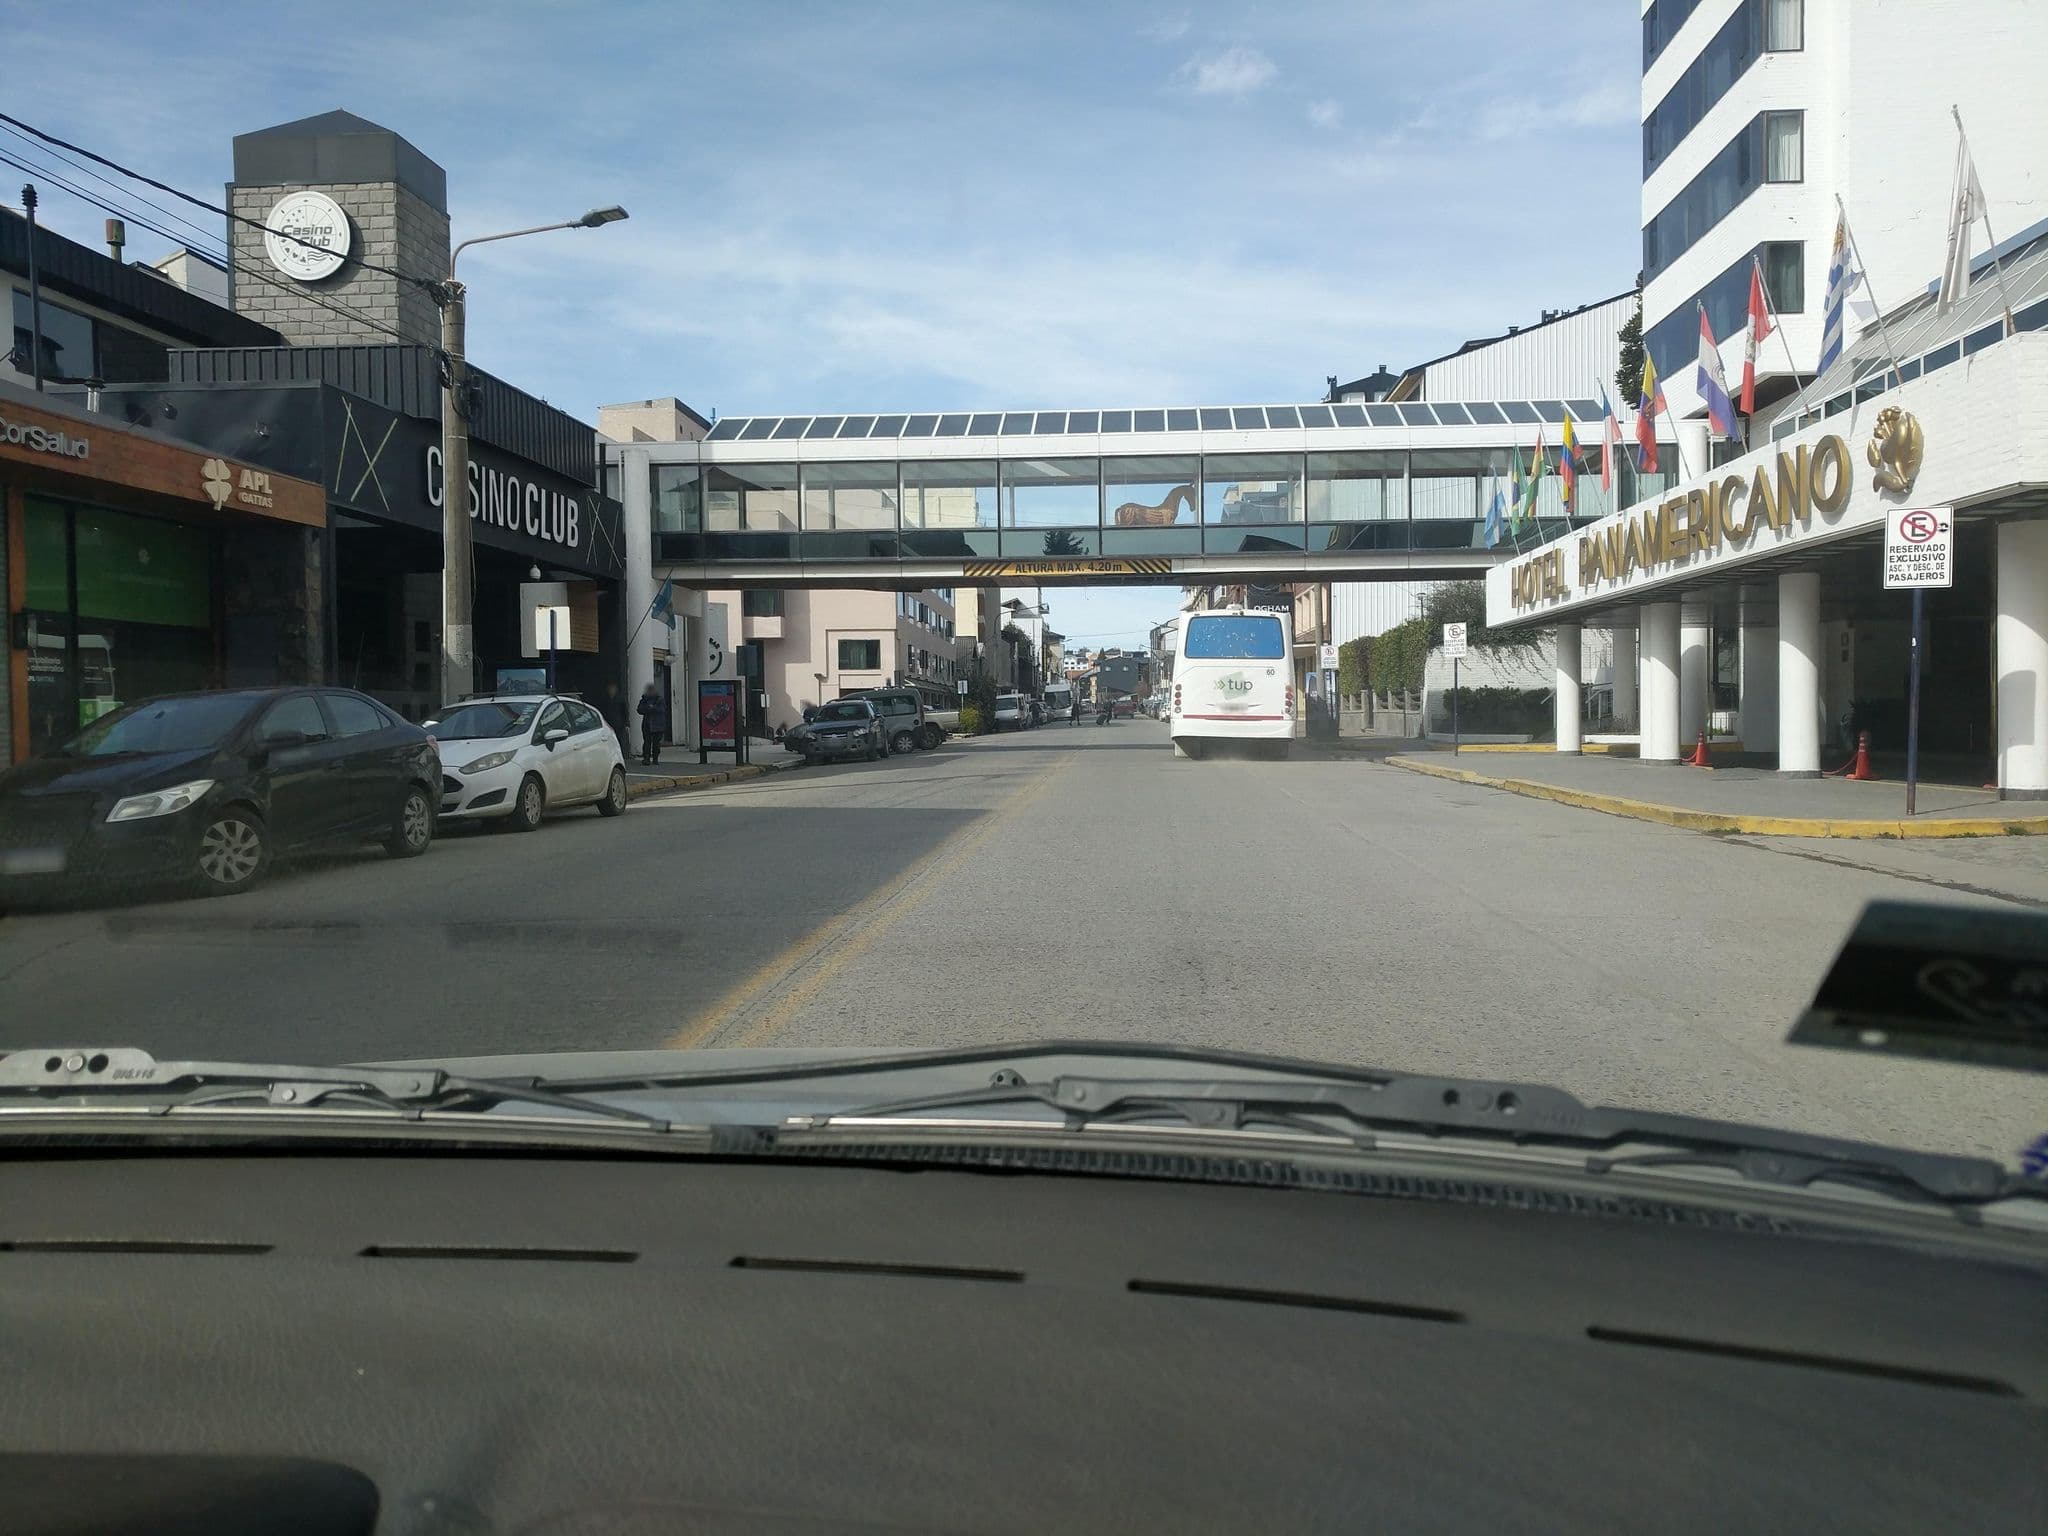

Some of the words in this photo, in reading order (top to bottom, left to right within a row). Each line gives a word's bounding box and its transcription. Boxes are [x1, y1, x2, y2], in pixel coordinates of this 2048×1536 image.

[281, 224, 333, 236] Casino
[238, 469, 273, 494] APL
[427, 445, 520, 532] CSINO
[239, 491, 273, 508] GATTAS
[1511, 547, 1568, 609] HOTEL
[1578, 434, 1851, 588] PANAMERICANO
[1889, 544, 1946, 554] RESERVADO
[1889, 553, 1946, 563] EXCLUSIVO
[1015, 562, 1053, 574] ALTURA
[1057, 562, 1085, 573] MAX.
[1888, 564, 1905, 573] ASC.
[1907, 564, 1912, 572] Y
[1913, 562, 1934, 572] DESC.
[1936, 562, 1945, 570] DE
[1888, 571, 1945, 582] PASAJEROS
[1228, 679, 1253, 692] tup
